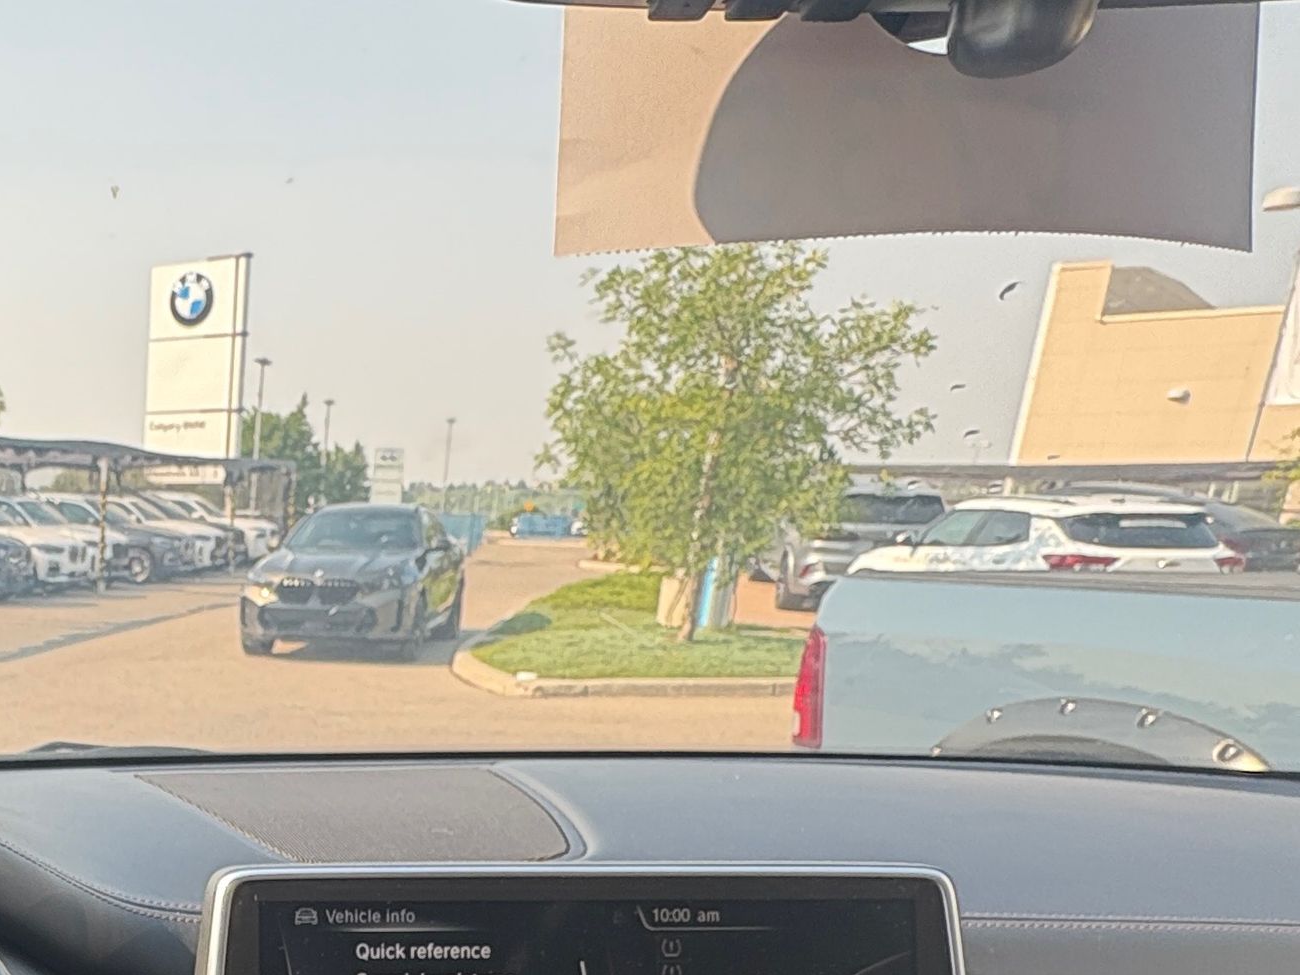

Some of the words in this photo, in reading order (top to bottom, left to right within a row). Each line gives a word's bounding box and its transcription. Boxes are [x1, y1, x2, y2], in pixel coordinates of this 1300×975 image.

[325, 909, 381, 924] Vehicle
[386, 909, 416, 924] info
[652, 908, 691, 923] 10:00
[697, 911, 720, 923] am
[355, 943, 406, 961] Quick
[410, 943, 492, 959] reference
